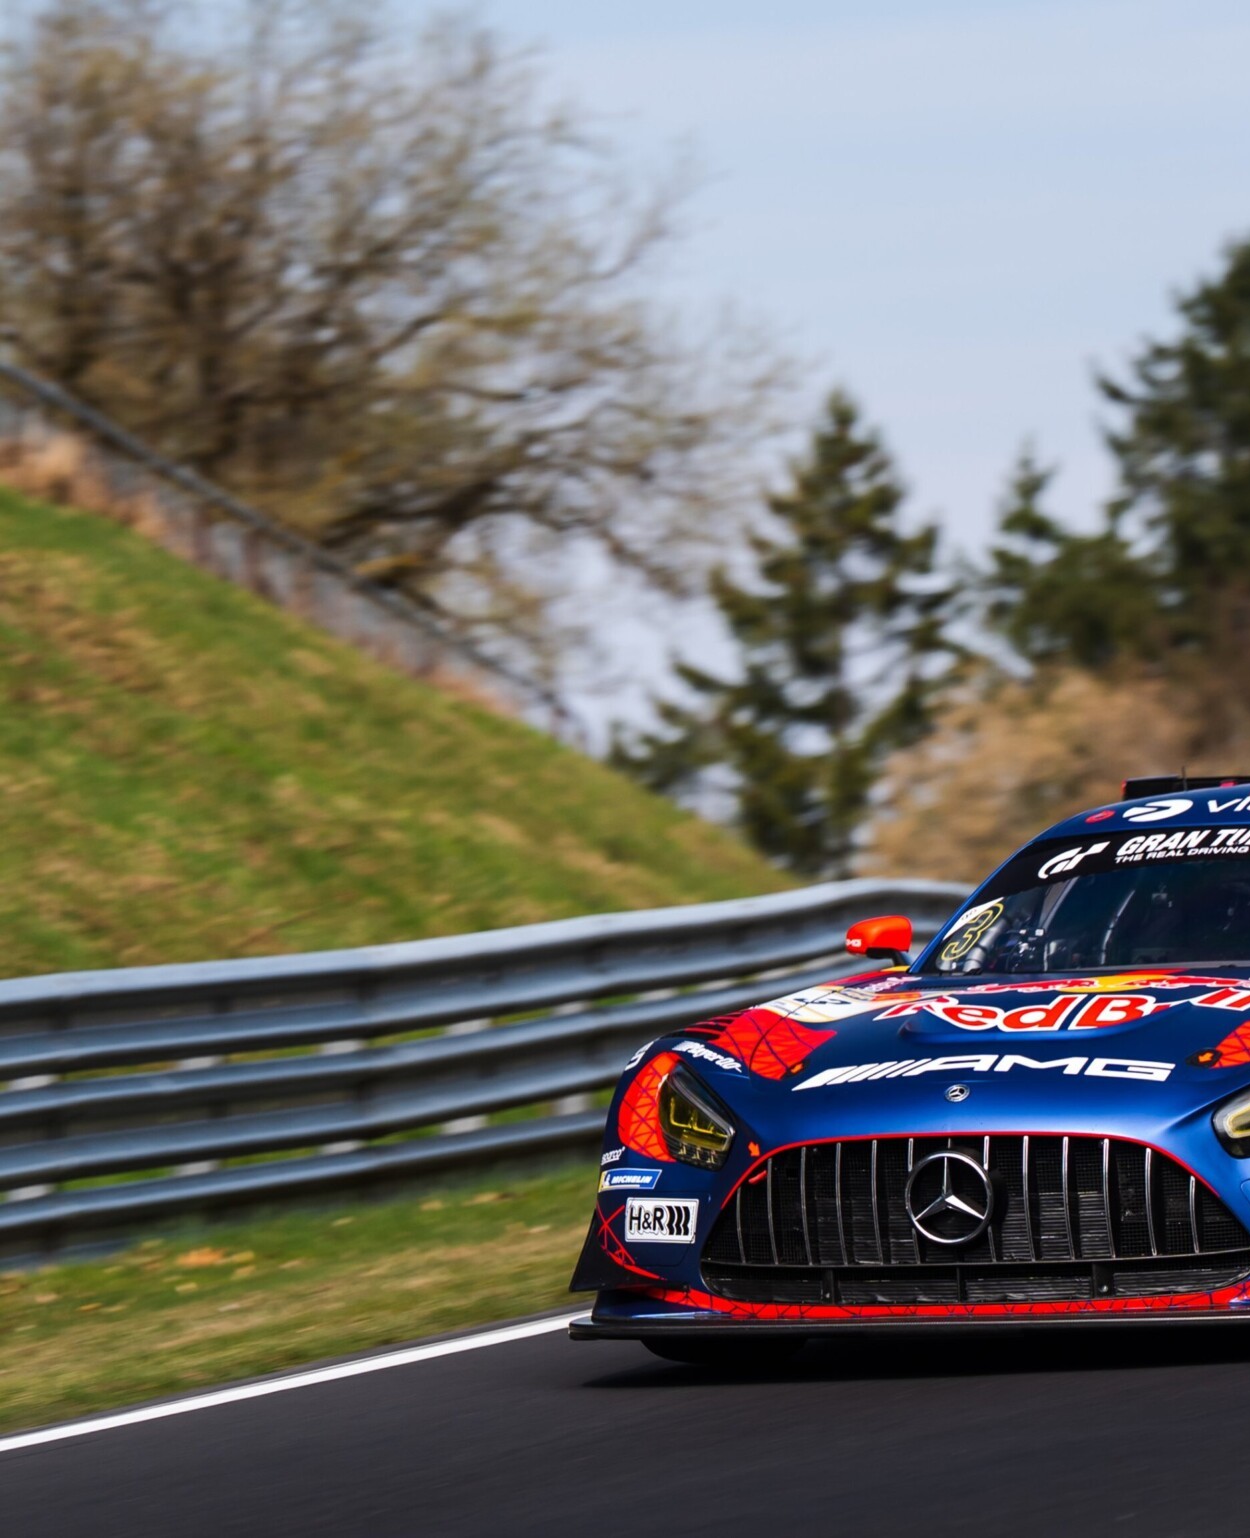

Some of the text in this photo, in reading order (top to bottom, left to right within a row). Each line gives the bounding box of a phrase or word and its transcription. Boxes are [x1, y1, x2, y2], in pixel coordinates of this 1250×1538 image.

[1115, 829, 1211, 857] GRAN
[1115, 854, 1142, 864] THE
[1146, 849, 1184, 860] REAL
[1187, 845, 1249, 857] DRIVING
[942, 902, 1004, 961] 3
[874, 993, 1076, 1032] Red
[906, 1054, 1176, 1082] AMG
[611, 1176, 653, 1185] MICHELIN
[628, 1206, 664, 1232] H&R
